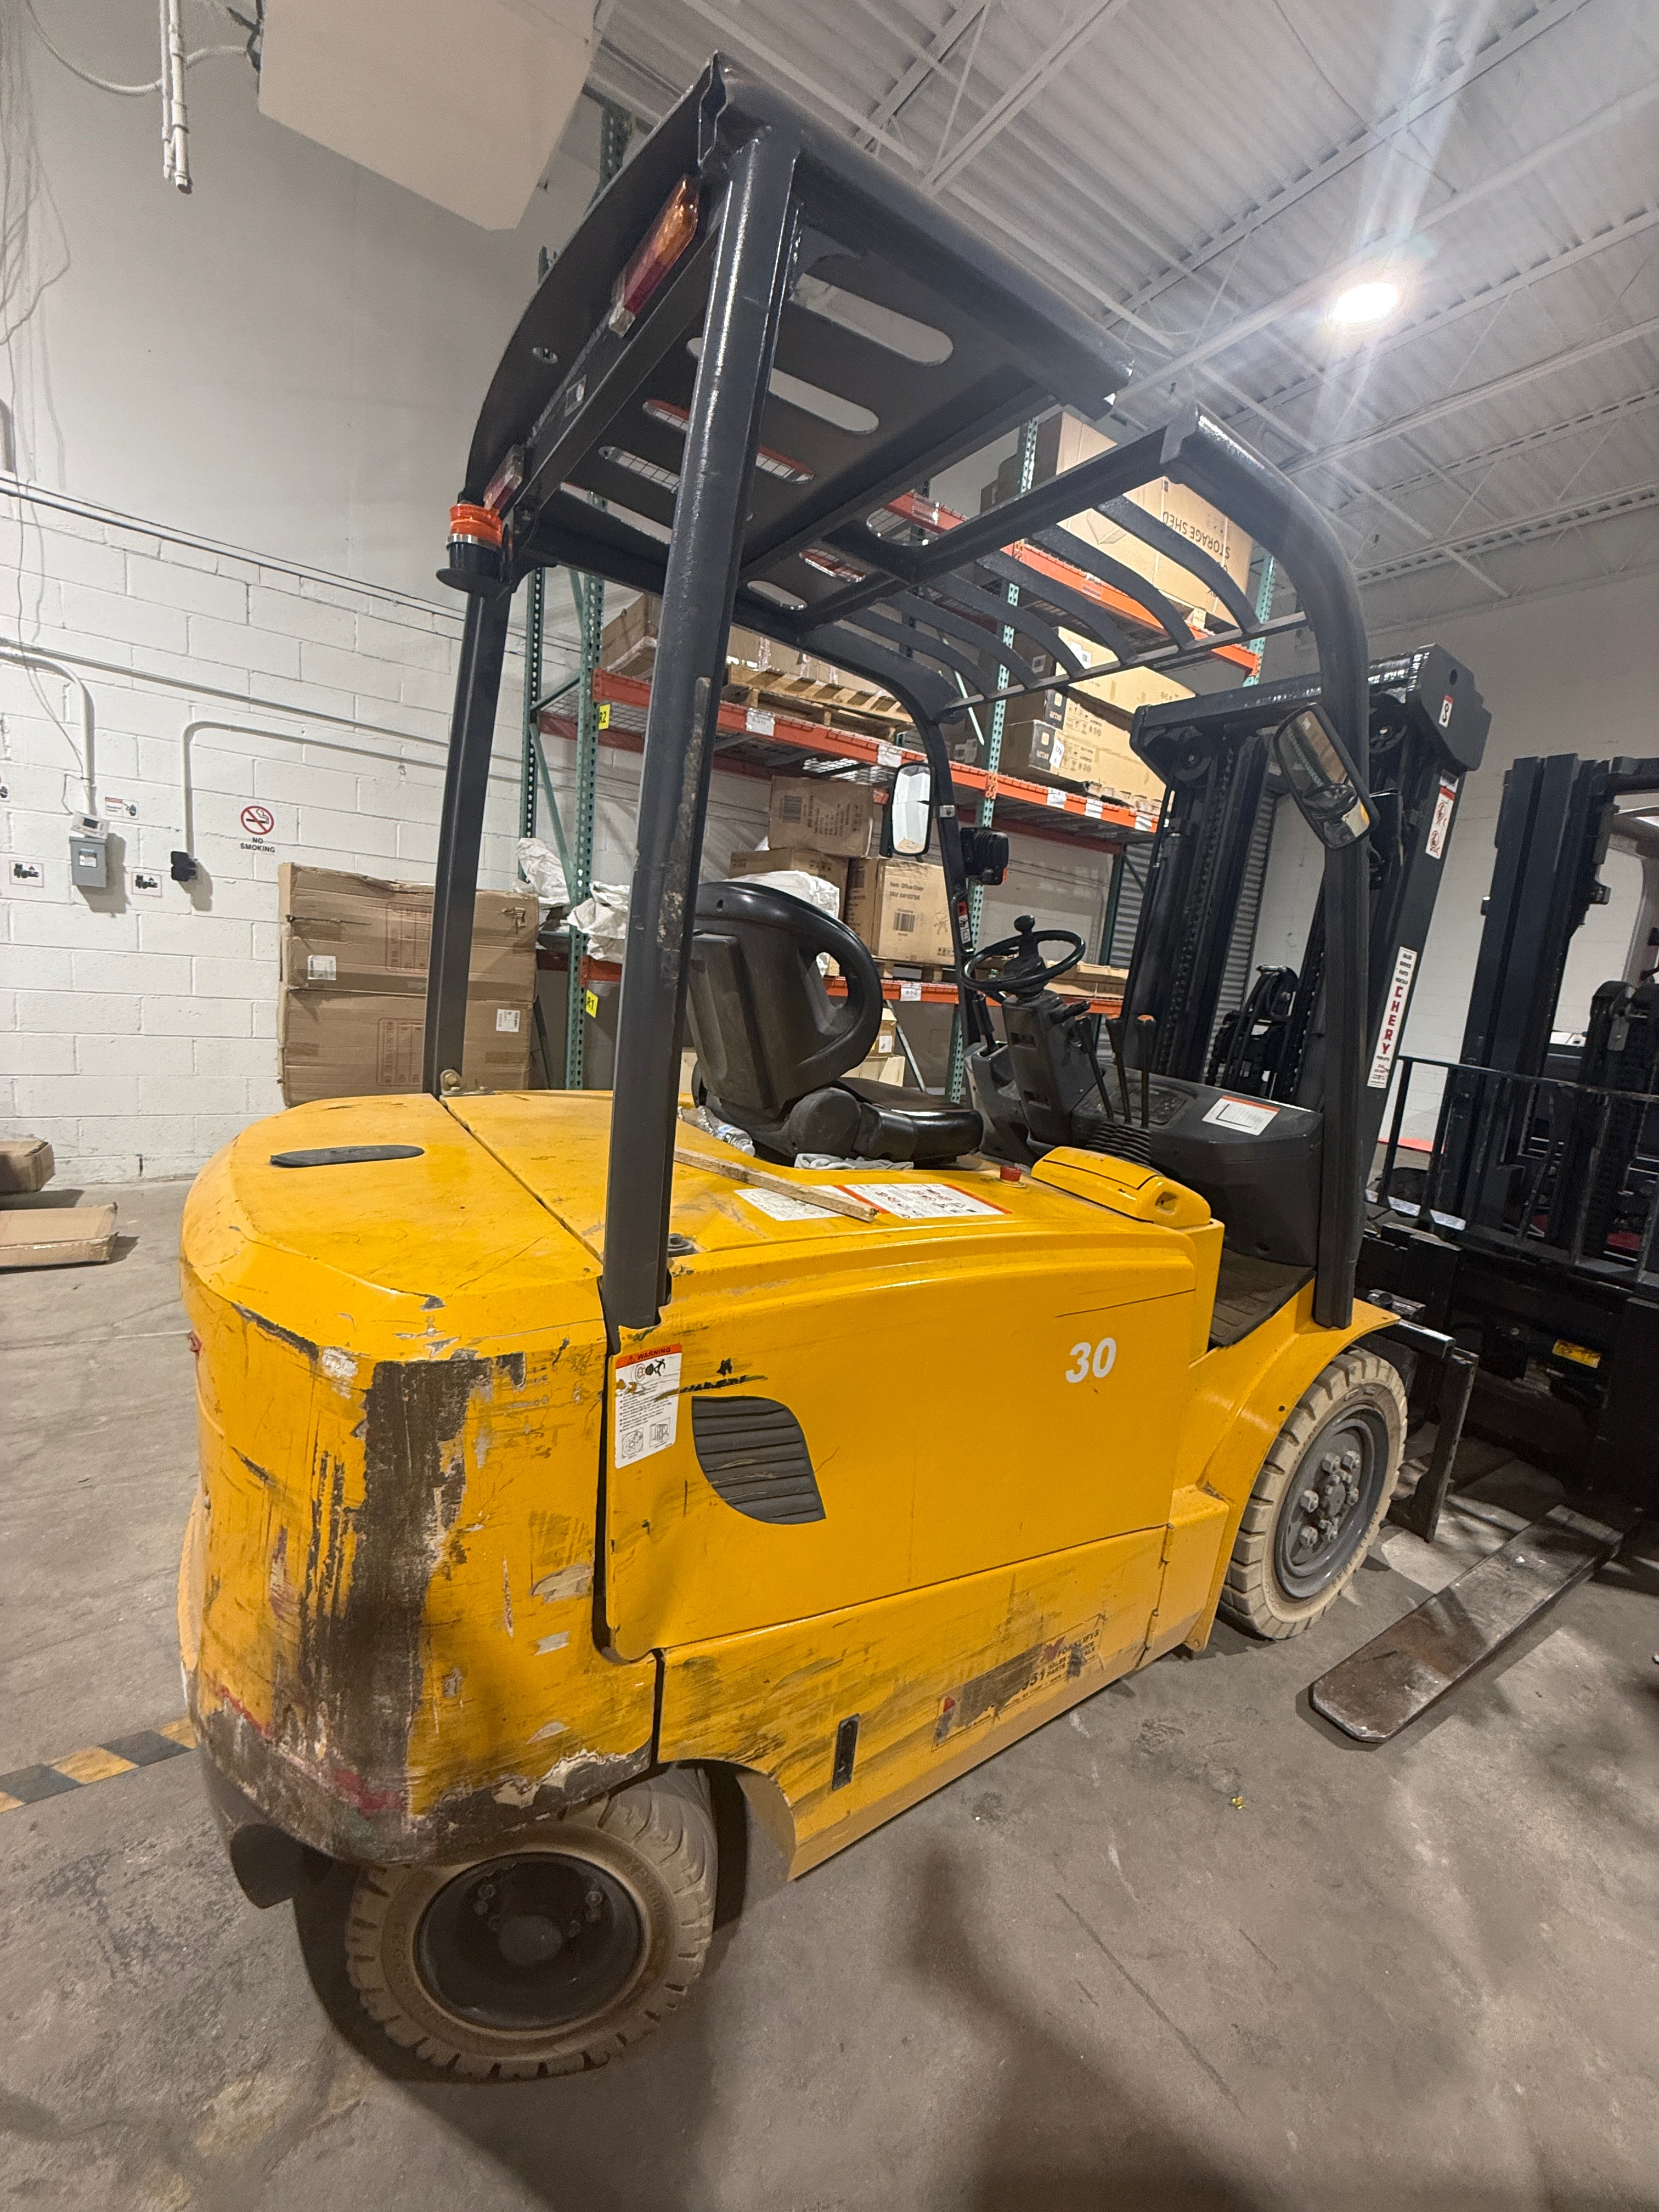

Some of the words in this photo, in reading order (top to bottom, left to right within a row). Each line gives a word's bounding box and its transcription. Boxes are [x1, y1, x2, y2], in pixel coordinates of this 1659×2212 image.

[1163, 511, 1188, 534] SHED
[1189, 526, 1231, 559] STORAGE
[240, 843, 275, 853] SMOKING
[588, 996, 594, 1010] R1
[1382, 986, 1403, 1054] CHERY
[637, 1347, 672, 1361] WARNING
[1065, 1338, 1116, 1383] 30
